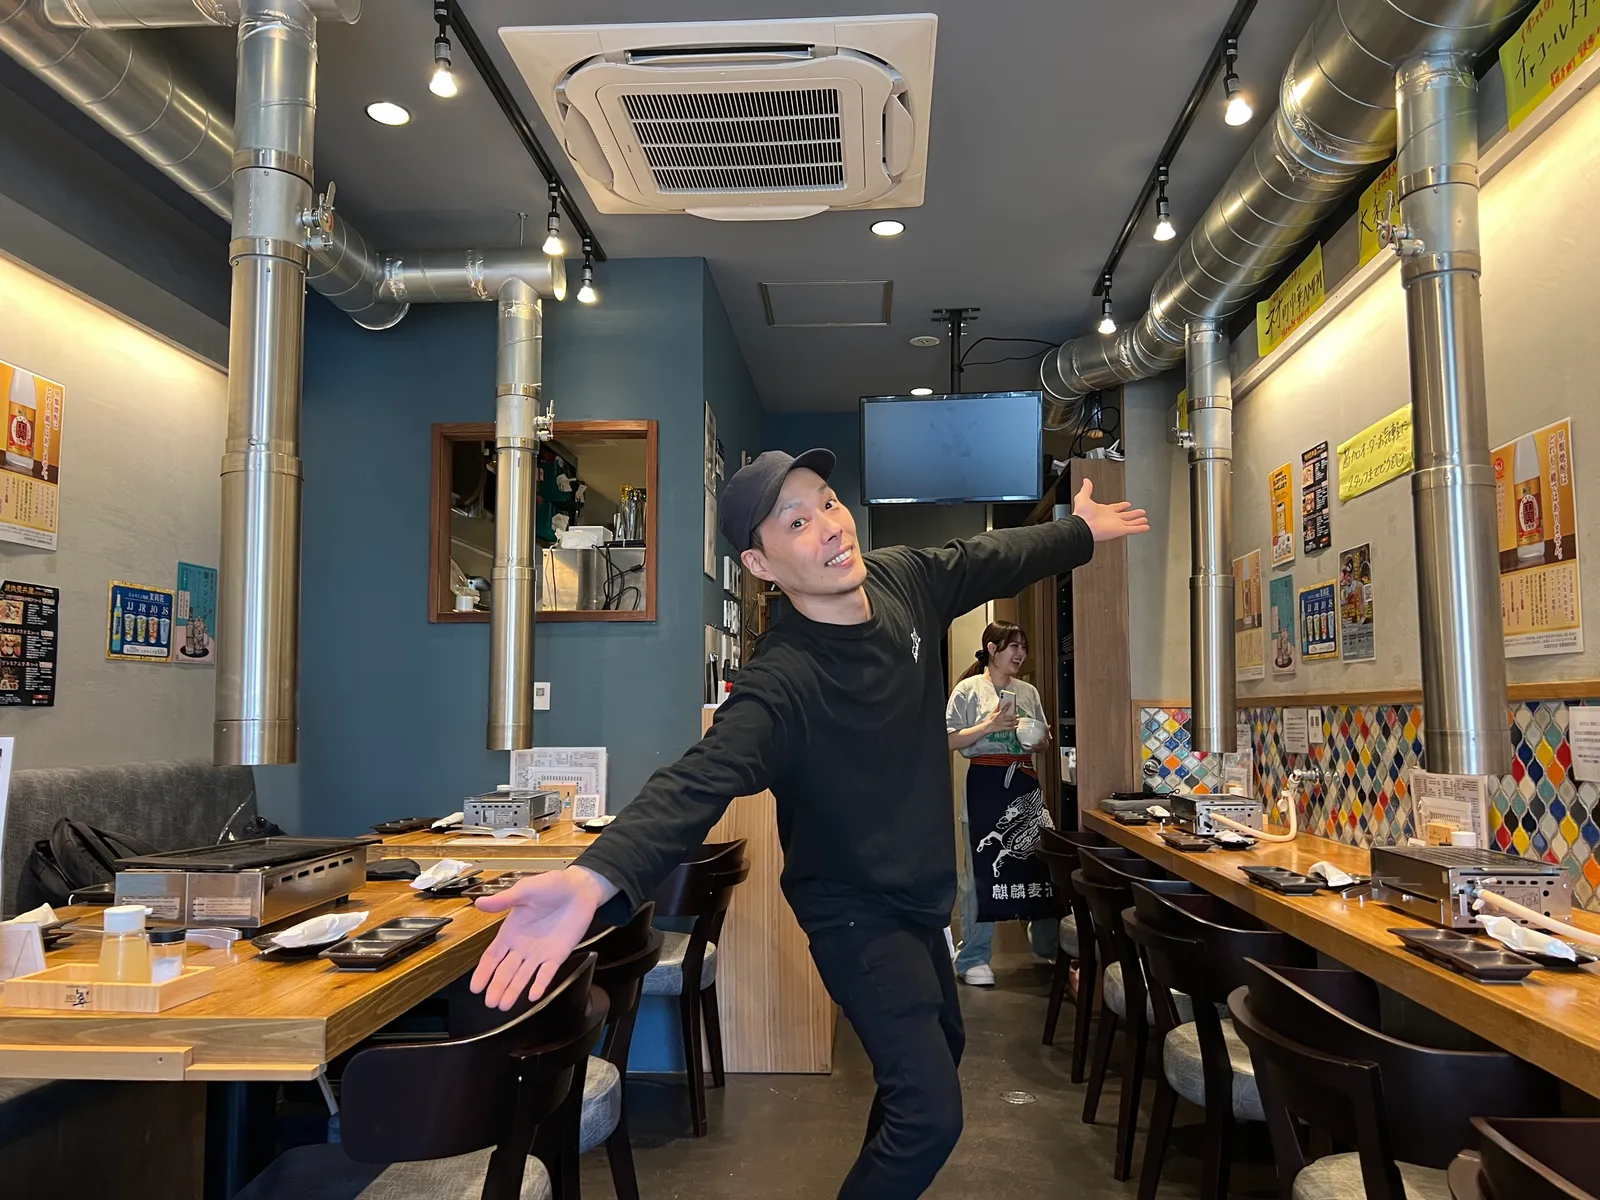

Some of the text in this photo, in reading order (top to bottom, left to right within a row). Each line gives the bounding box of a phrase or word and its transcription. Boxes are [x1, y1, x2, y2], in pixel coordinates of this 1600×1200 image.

[126, 601, 134, 611] JJ
[138, 603, 146, 613] JR
[150, 605, 158, 614] JO
